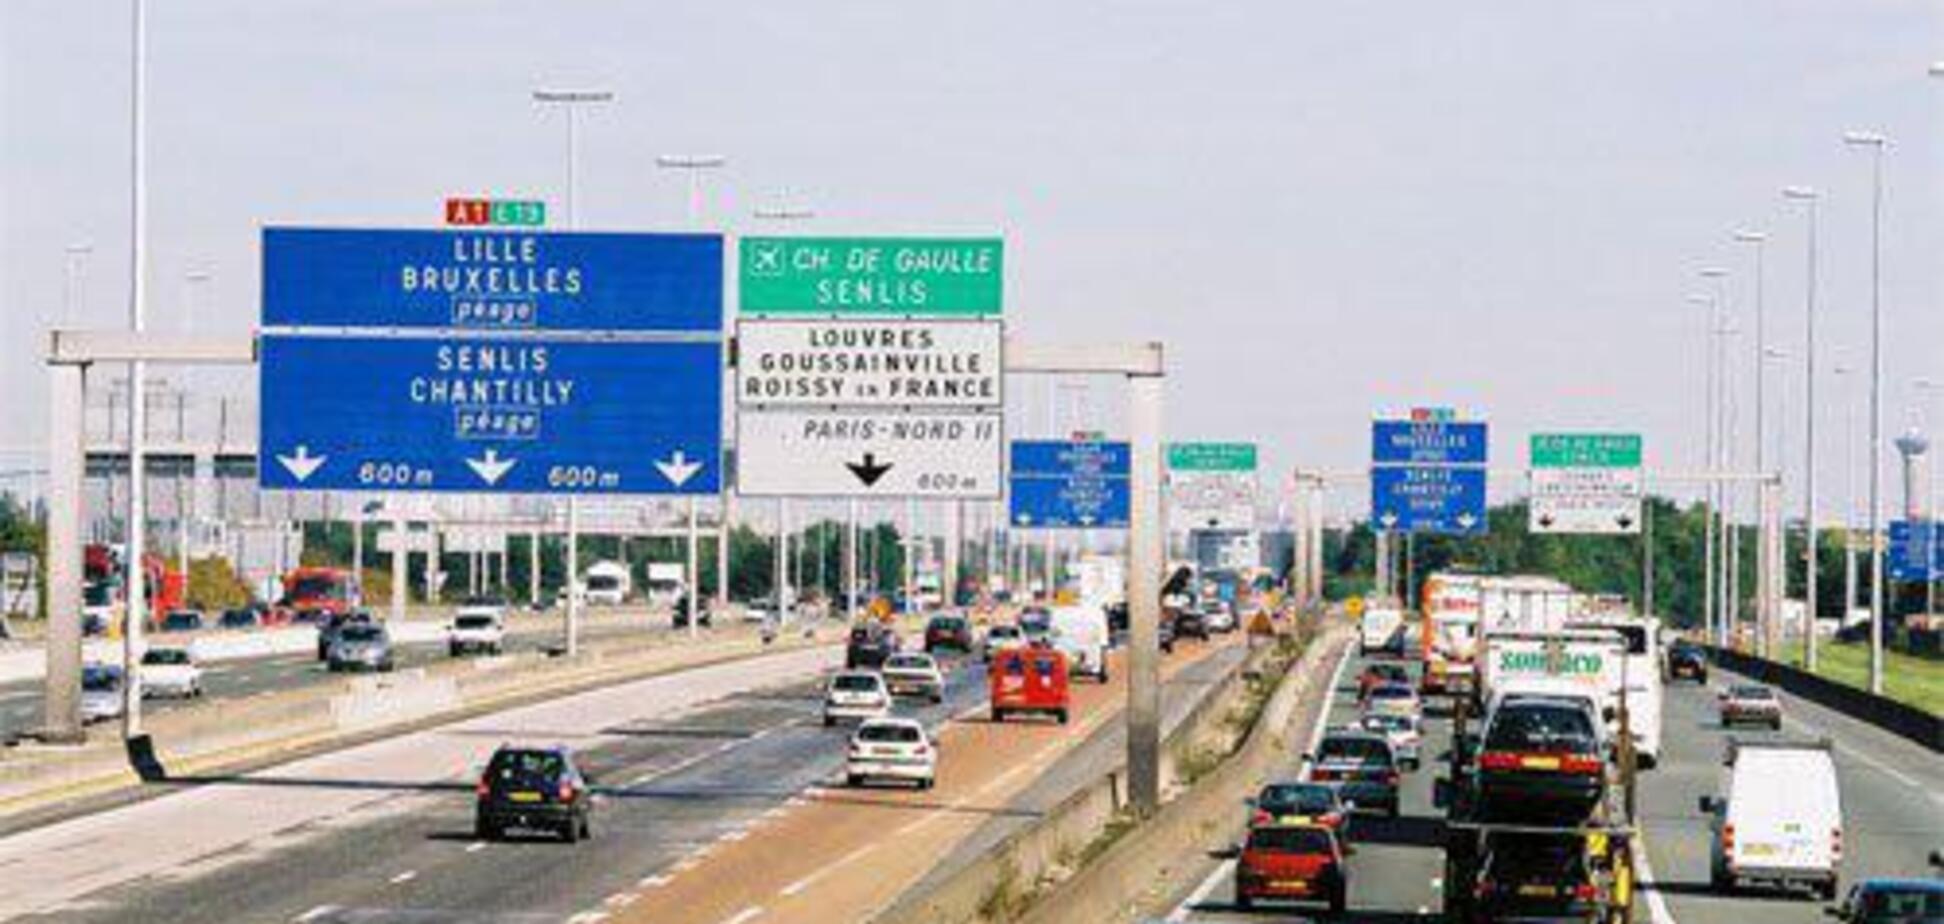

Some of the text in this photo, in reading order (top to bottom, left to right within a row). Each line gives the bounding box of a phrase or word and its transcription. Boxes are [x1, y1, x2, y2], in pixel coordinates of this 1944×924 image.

[453, 237, 536, 263] LILLE
[791, 247, 994, 274] CH DE GAULLE
[402, 265, 582, 294] BRUXELLES
[816, 279, 927, 305] SENLIS
[809, 329, 934, 349] LOUVRES
[436, 345, 549, 373] SENLIS
[760, 353, 982, 373] GOUSSAINVILLE
[409, 378, 575, 406] CHANTILLY
[746, 377, 845, 397] ROISSY
[890, 377, 994, 398] FRANCE
